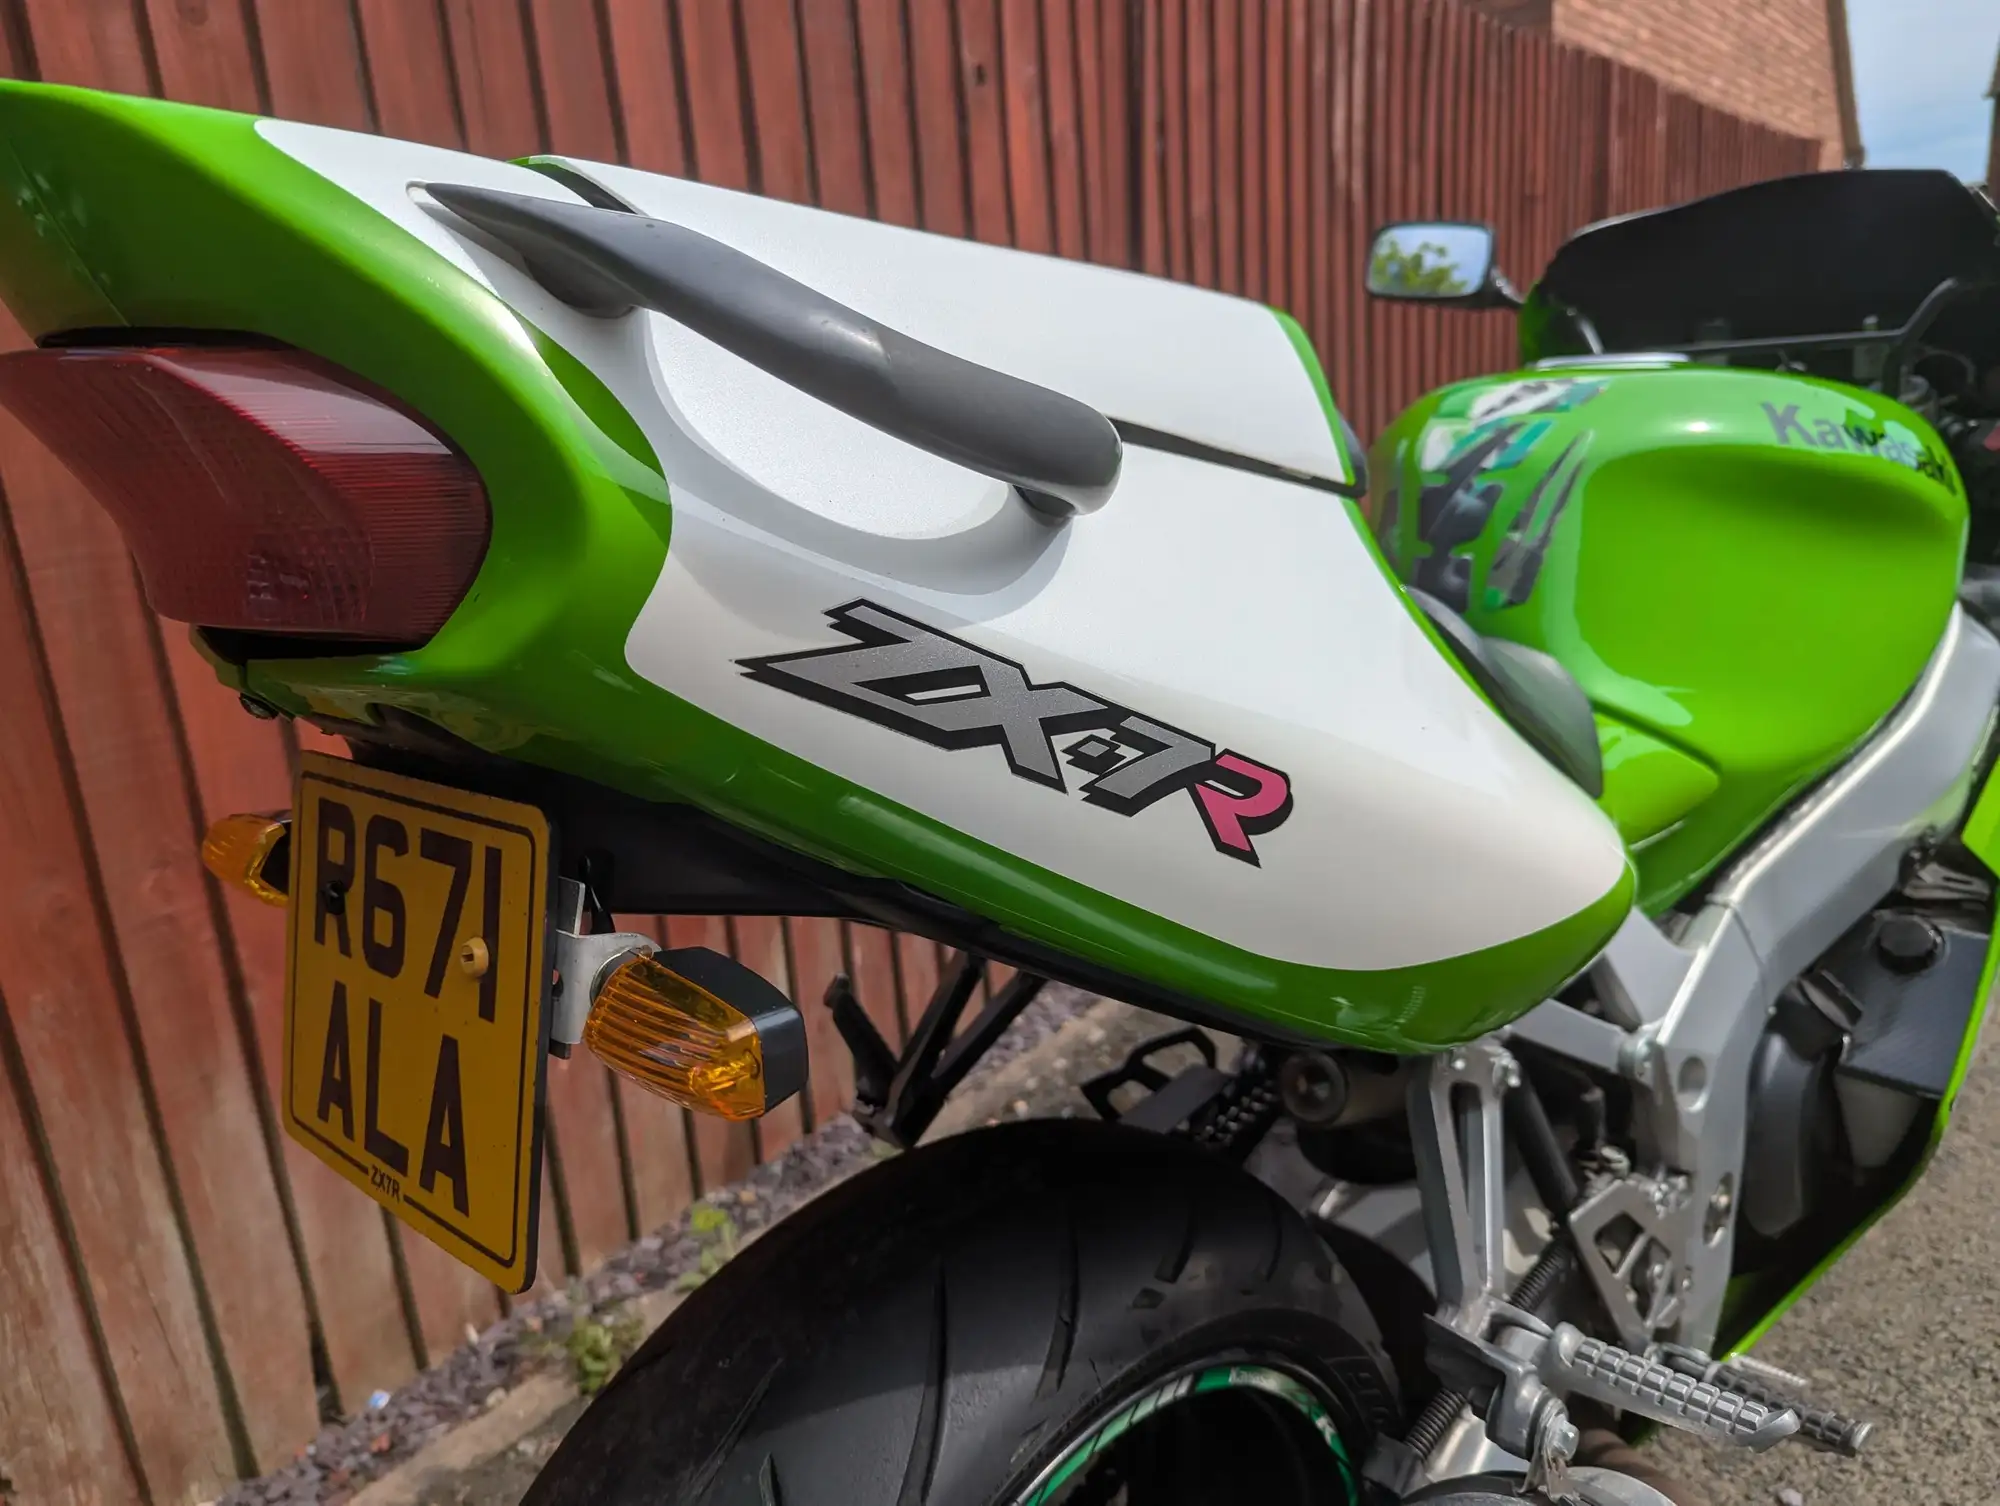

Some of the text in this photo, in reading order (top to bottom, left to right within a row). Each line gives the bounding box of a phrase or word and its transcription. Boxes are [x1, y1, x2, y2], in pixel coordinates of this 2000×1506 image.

[314, 797, 502, 1023] R671
[317, 980, 470, 1218] ALA
[370, 1164, 400, 1204] ZX7R
